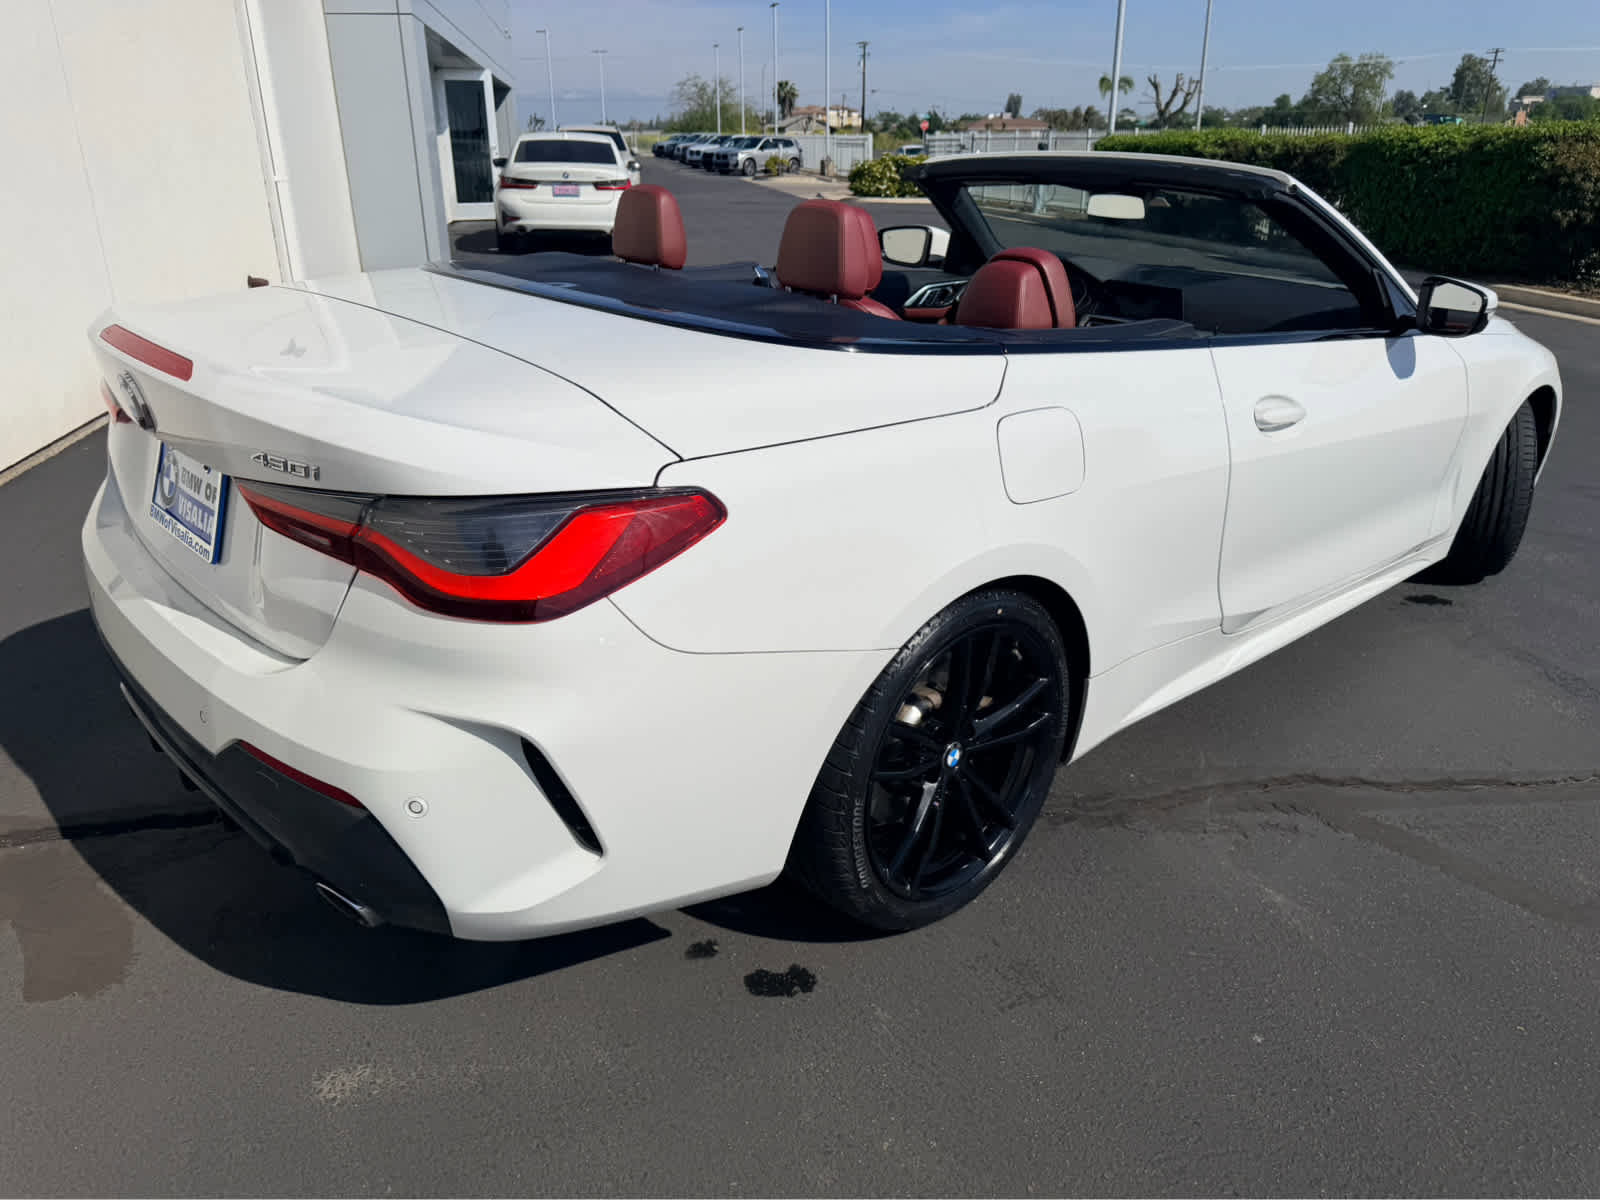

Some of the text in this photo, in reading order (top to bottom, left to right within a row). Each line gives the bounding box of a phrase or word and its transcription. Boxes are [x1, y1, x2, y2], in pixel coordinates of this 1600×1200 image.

[180, 466, 217, 504] BMW OF
[251, 451, 320, 481] 430i
[150, 504, 210, 561] BMWofVisalia.com
